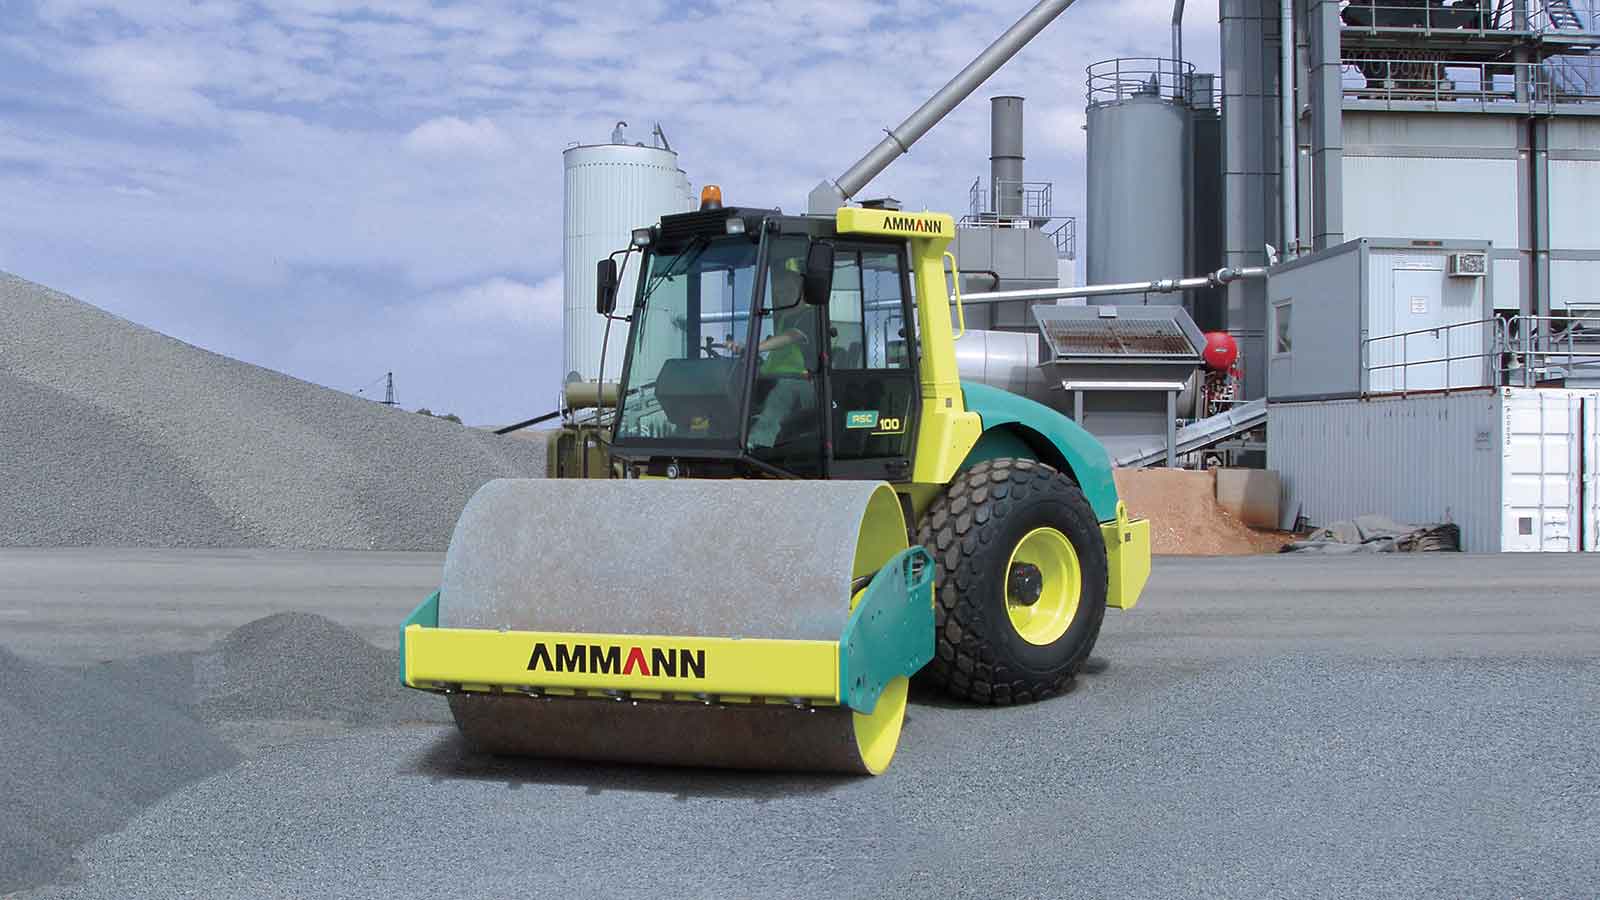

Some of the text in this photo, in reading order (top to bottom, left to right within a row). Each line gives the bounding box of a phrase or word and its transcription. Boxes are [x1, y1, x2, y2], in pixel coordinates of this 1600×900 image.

[883, 216, 942, 233] AMMANN
[879, 418, 900, 430] 100
[527, 643, 705, 678] AMMANN
